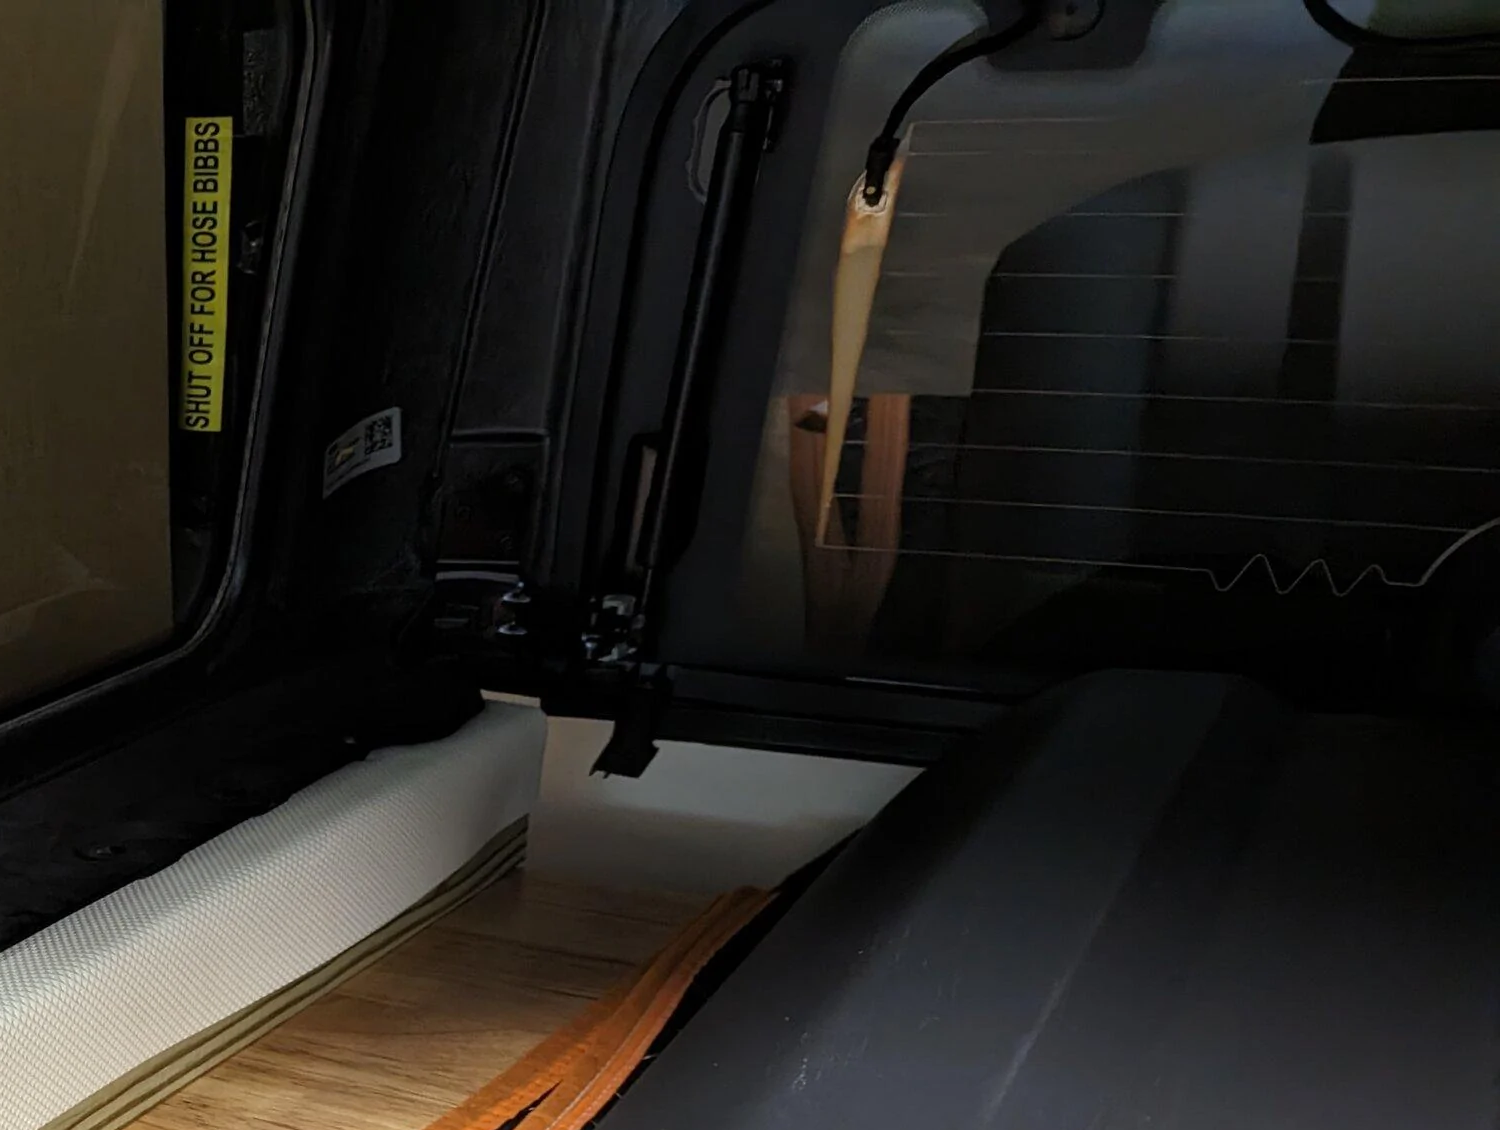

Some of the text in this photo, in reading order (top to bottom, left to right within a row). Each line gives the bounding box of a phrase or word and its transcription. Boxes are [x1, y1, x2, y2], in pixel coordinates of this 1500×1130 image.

[185, 122, 219, 428] SHUT OFF FOR HOSE BIBBS
